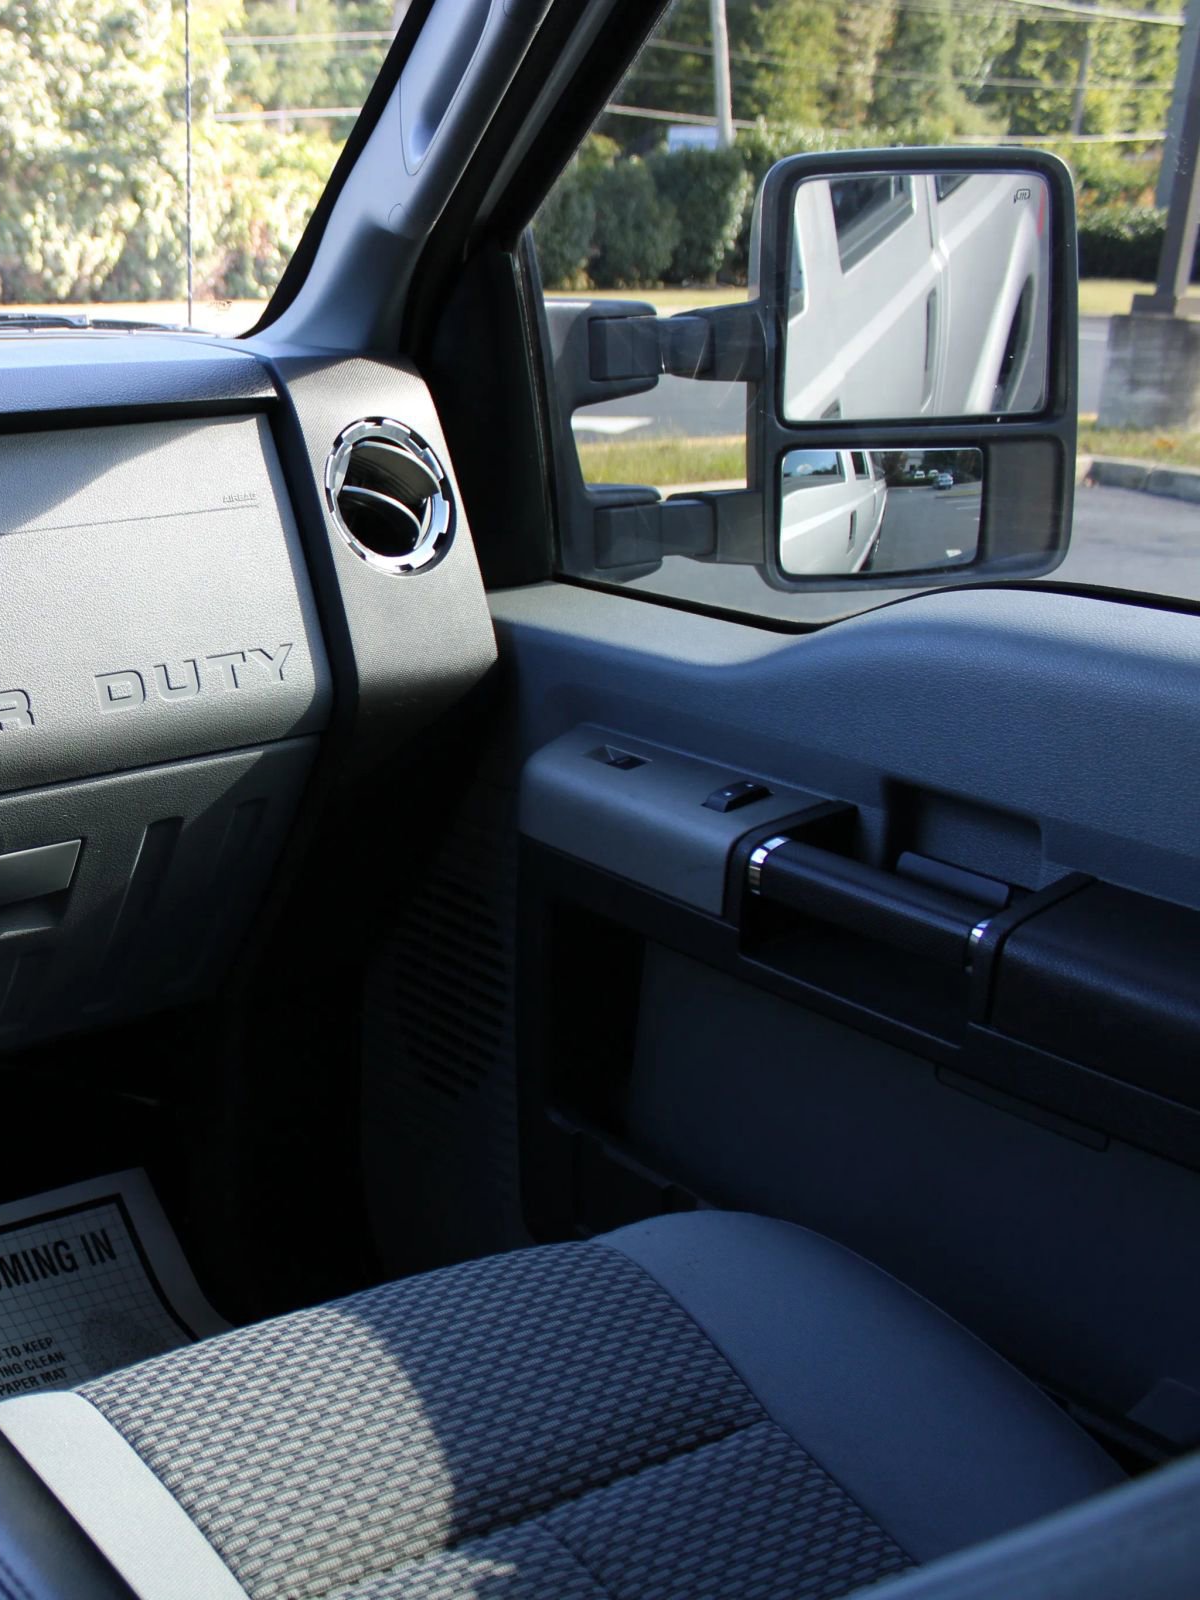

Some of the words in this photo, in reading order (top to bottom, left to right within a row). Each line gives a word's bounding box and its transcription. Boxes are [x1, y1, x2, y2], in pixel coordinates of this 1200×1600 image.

[94, 643, 294, 715] DUTY
[80, 1229, 117, 1266] IN
[2, 1345, 22, 1359] TO
[22, 1337, 54, 1354] KEEP
[24, 1351, 66, 1370] CLEAN
[40, 1366, 68, 1383] MAT
